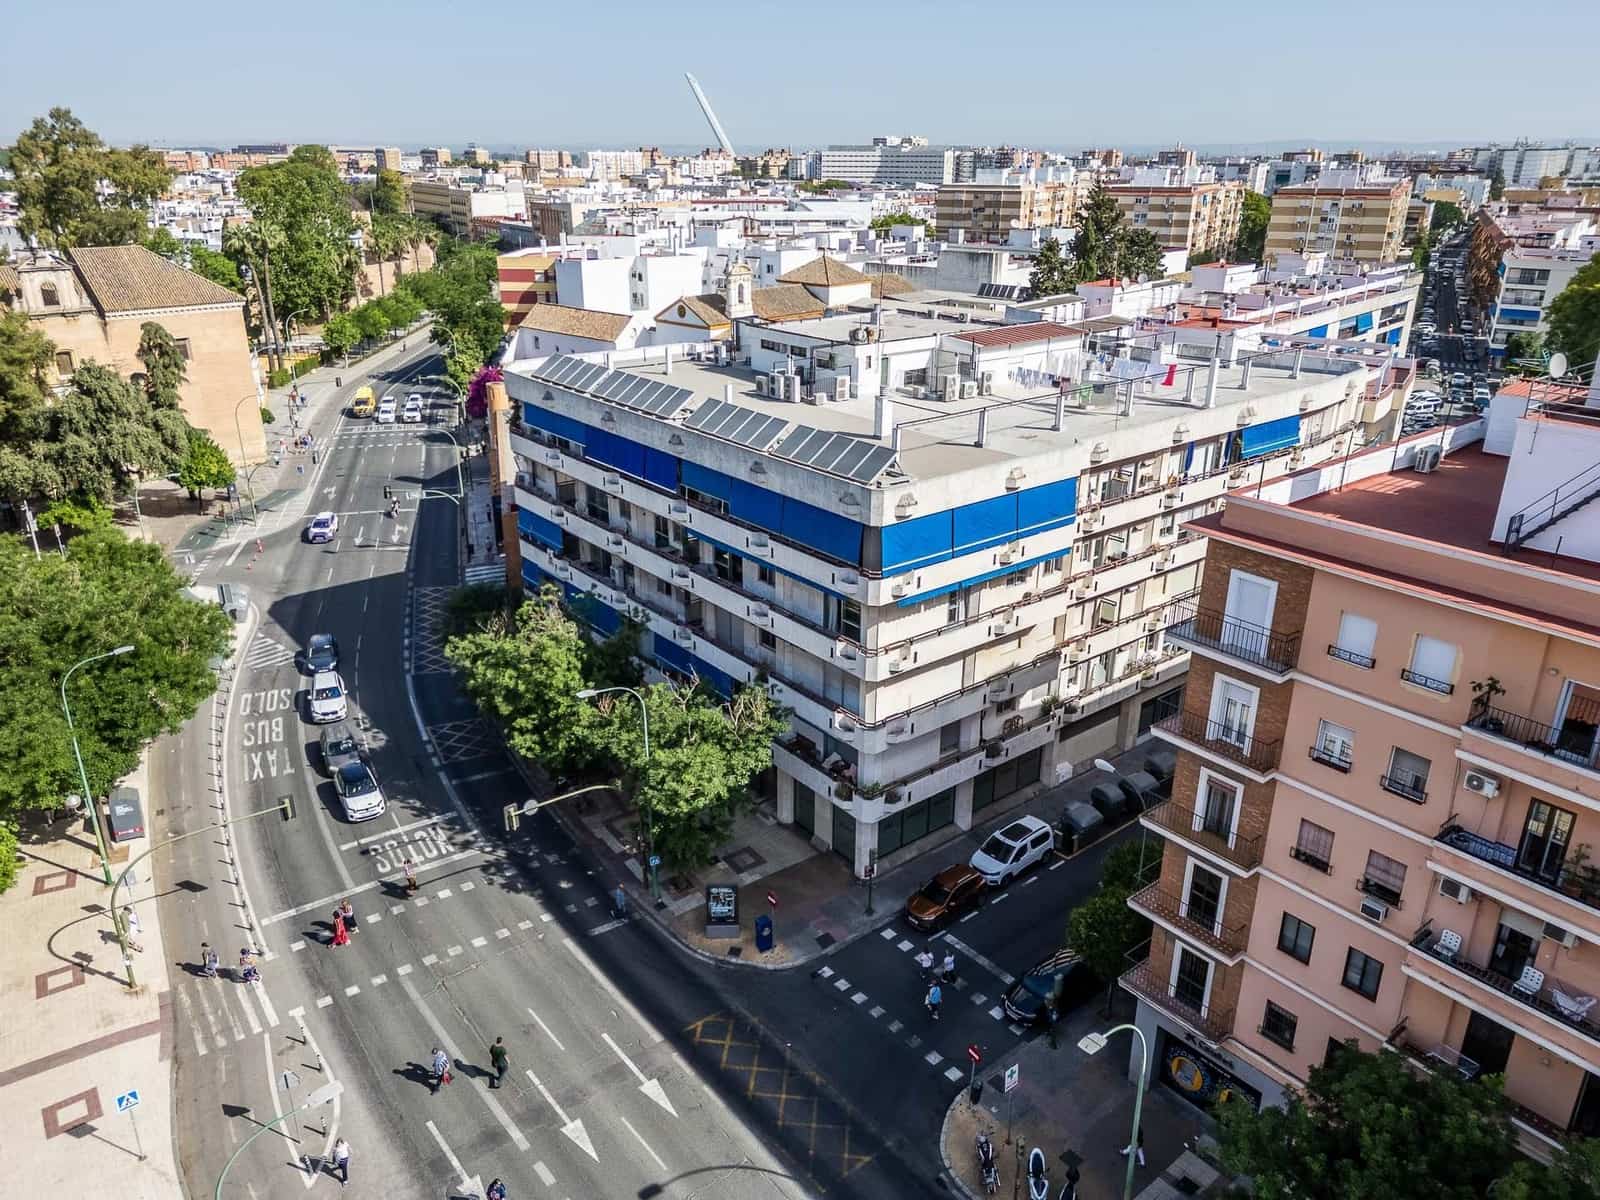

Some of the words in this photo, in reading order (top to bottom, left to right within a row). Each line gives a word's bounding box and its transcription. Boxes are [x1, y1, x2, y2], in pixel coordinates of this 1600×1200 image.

[240, 688, 291, 716] SOLO
[243, 717, 283, 746] BUS
[243, 748, 295, 782] TAXI
[369, 825, 455, 873] MOTOS
